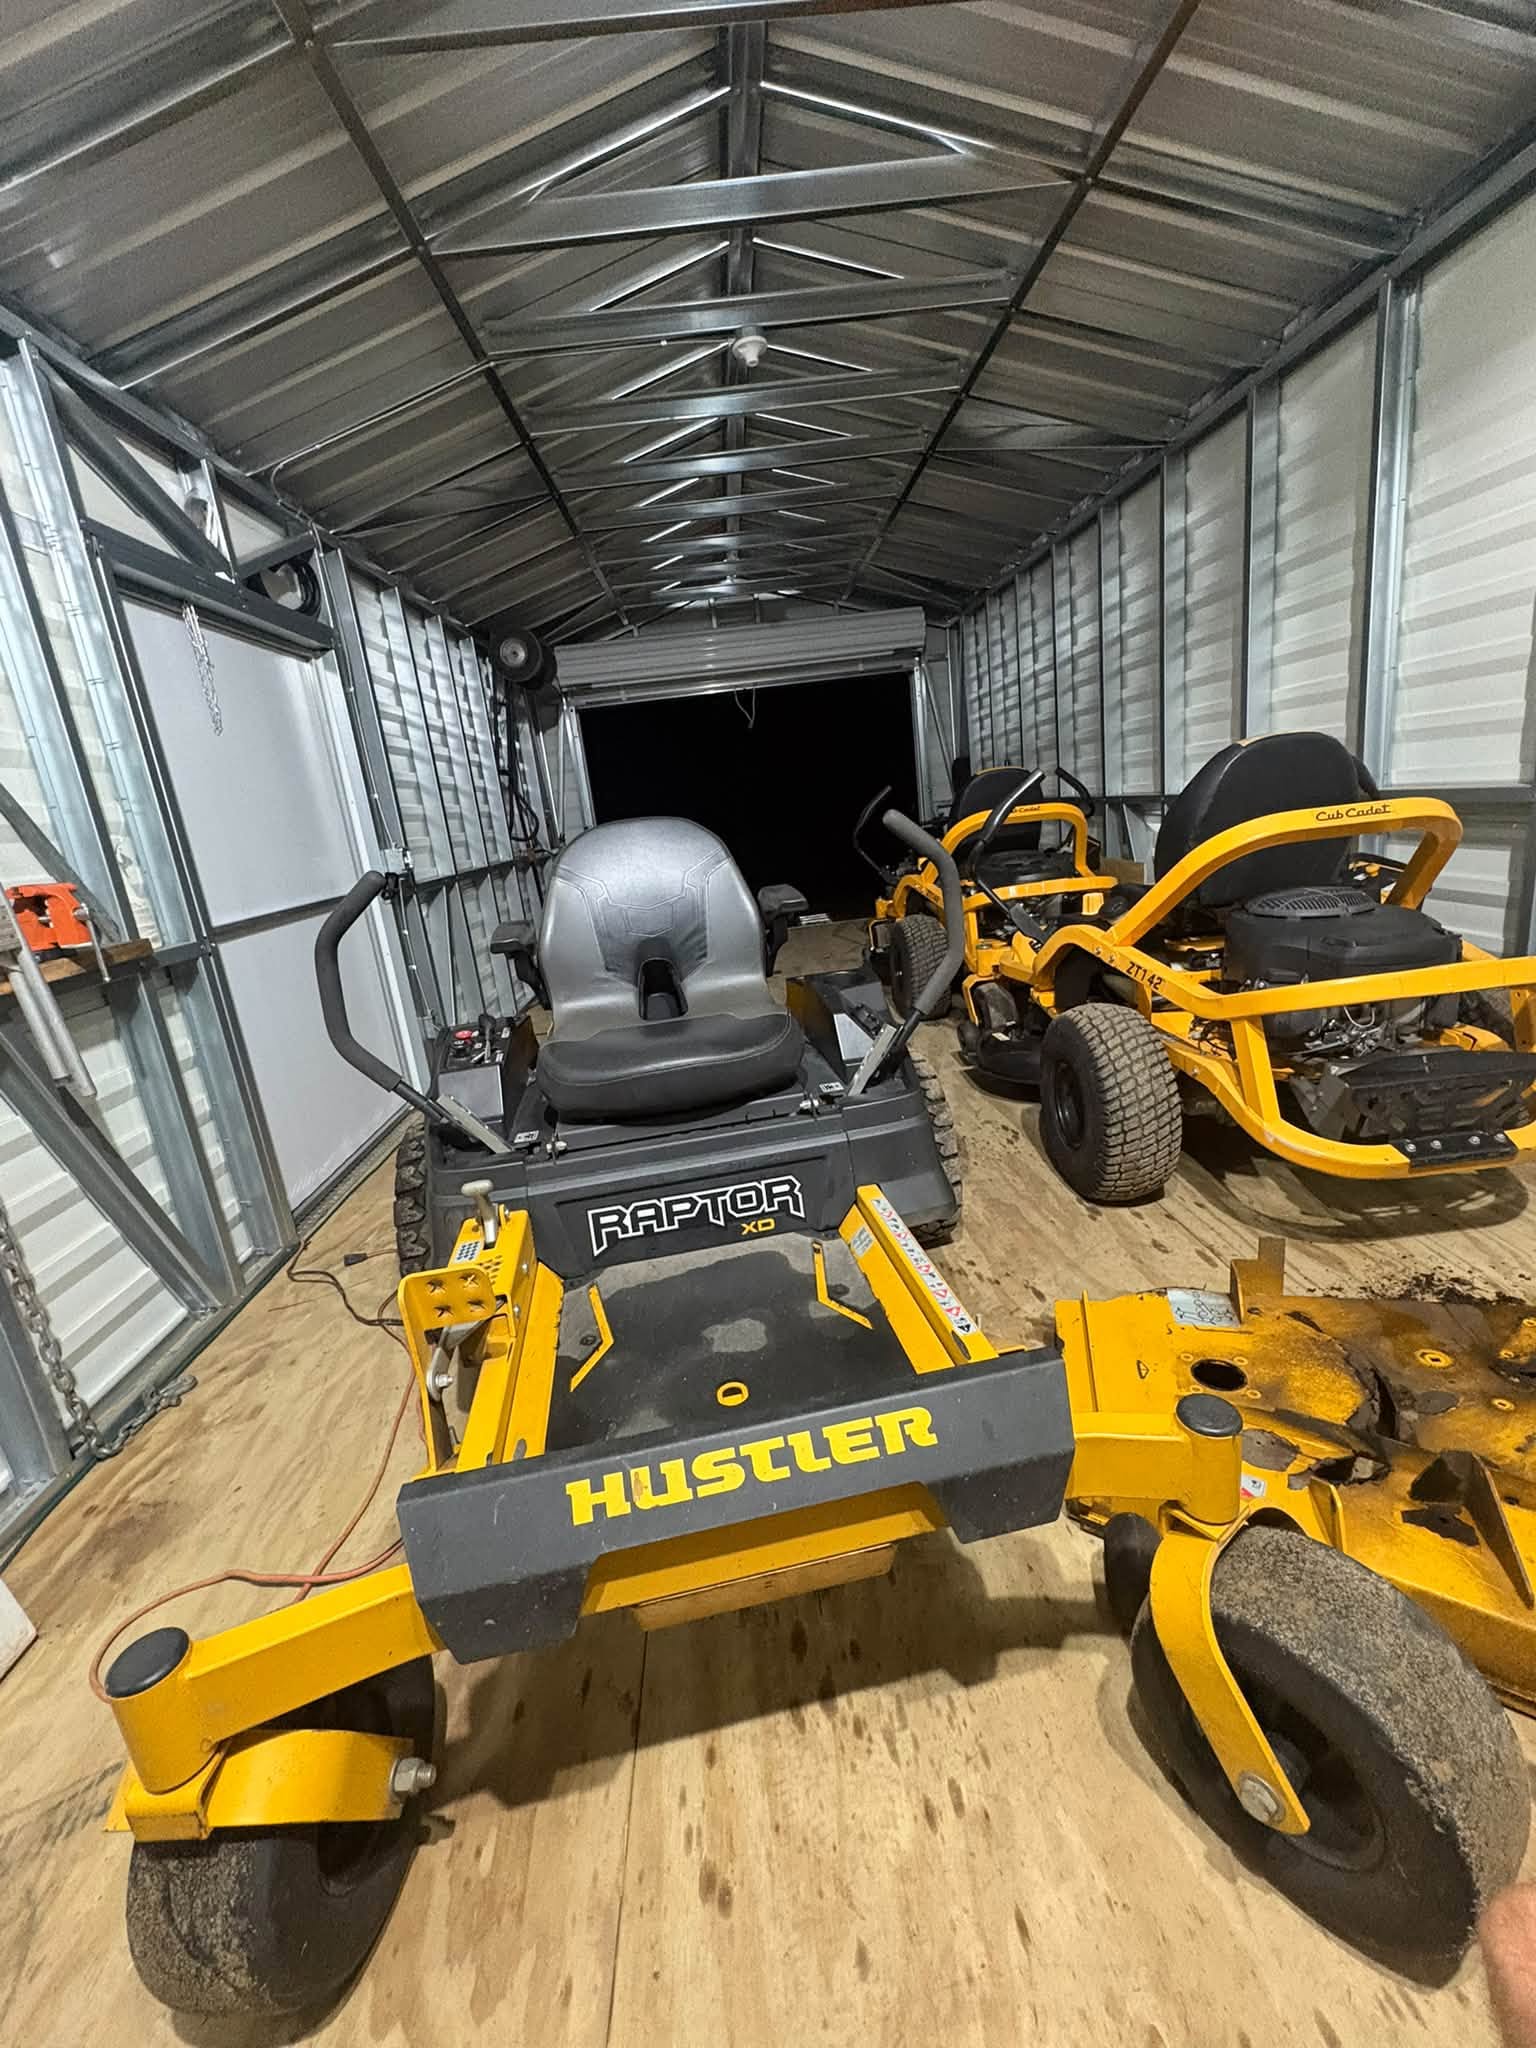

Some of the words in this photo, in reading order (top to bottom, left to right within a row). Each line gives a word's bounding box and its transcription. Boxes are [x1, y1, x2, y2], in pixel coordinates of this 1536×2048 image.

[1315, 810, 1344, 821] Cub
[1345, 803, 1392, 818] Cadet
[1147, 974, 1163, 990] 42
[587, 1175, 806, 1257] RAPTOR
[741, 1218, 775, 1235] XD
[565, 1406, 939, 1527] HUSTLER
